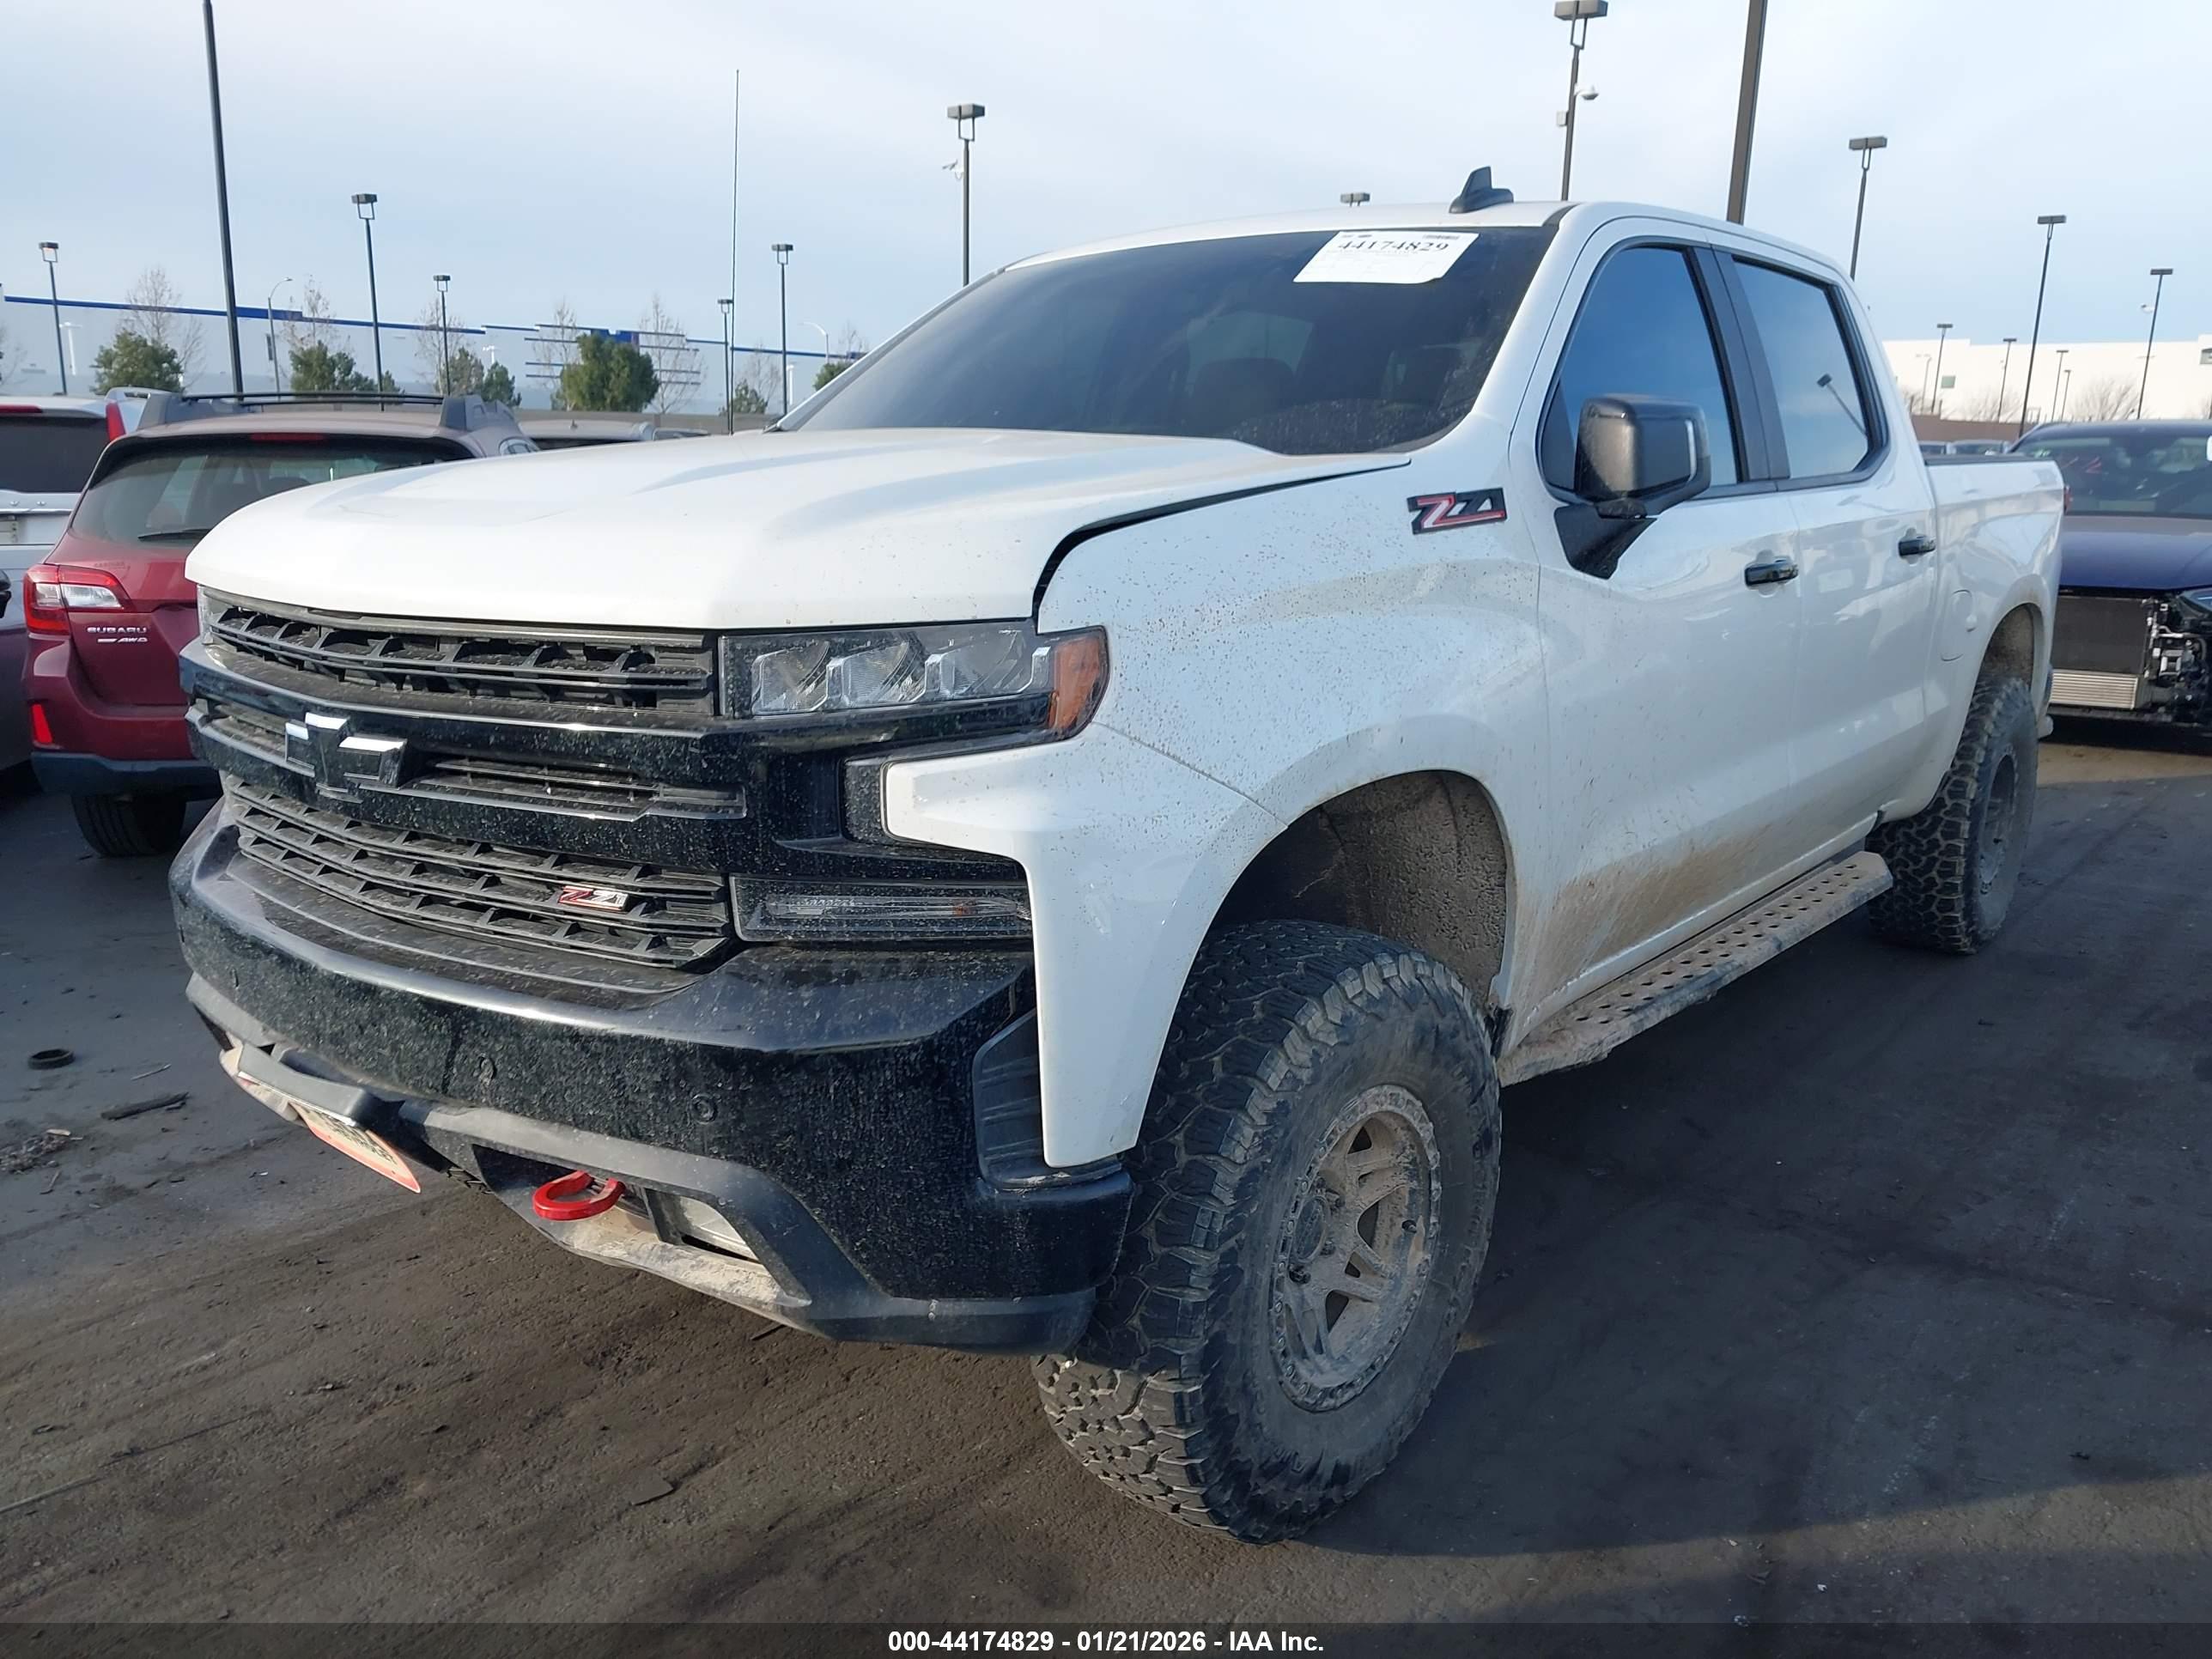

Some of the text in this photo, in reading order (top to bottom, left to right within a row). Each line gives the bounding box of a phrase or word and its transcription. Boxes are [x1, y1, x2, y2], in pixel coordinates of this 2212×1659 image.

[1337, 240, 1449, 252] 44174829
[1407, 487, 1508, 535] Z71
[558, 885, 629, 911] Z71
